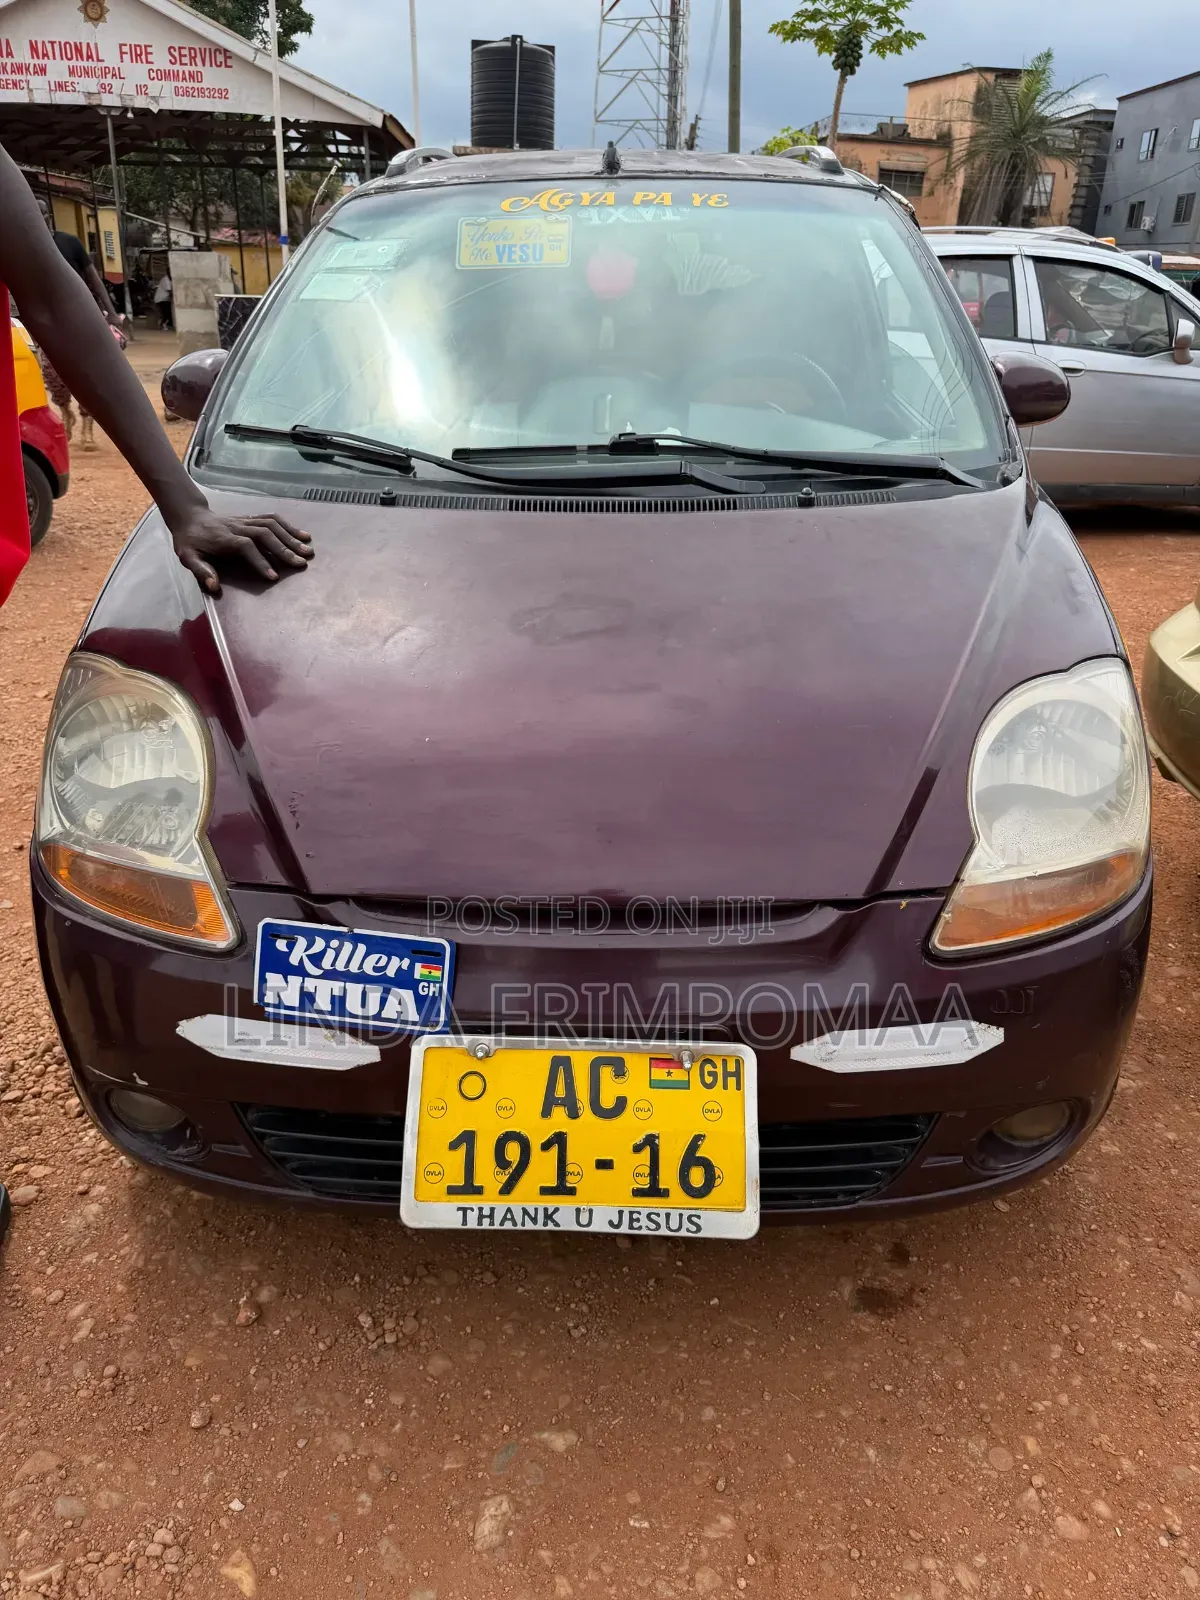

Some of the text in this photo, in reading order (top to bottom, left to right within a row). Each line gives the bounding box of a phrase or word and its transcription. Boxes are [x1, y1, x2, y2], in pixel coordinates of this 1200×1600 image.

[28, 39, 105, 63] NATIONAL
[119, 43, 154, 65] FIRE
[167, 45, 233, 69] SERVICE
[0, 61, 204, 83] KAWKAW MUNICIPAL COMMAND
[135, 84, 149, 96] 112
[174, 85, 230, 99] 0362193292
[500, 188, 616, 212] AGYA
[632, 191, 673, 206] PA
[495, 243, 545, 263] YESU
[275, 935, 411, 978] Killer
[264, 972, 420, 1022] NTUA
[418, 981, 440, 997] GH
[540, 1055, 628, 1119] AC
[699, 1057, 741, 1091] GH
[456, 1206, 703, 1234] THANK U JESUS
